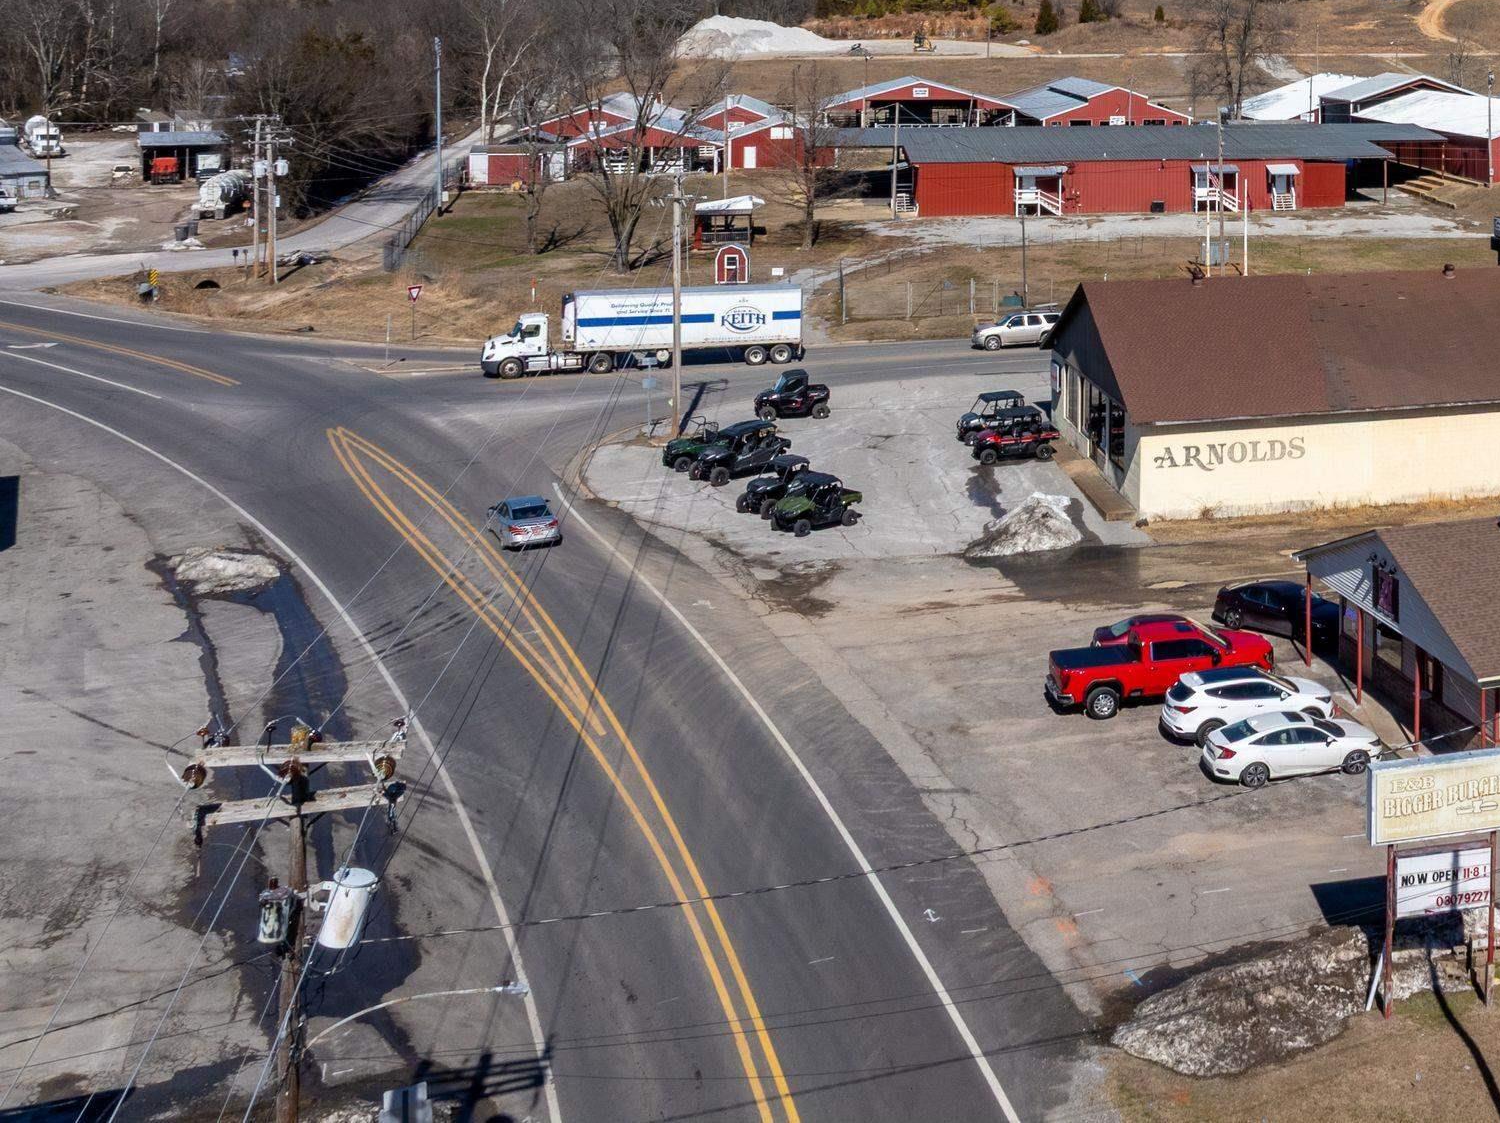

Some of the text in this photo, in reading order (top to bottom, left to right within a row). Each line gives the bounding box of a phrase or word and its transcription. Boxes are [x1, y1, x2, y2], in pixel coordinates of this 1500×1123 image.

[721, 313, 767, 328] KEITH
[1154, 437, 1306, 471] ARNOLDS
[1390, 776, 1435, 794] E&B
[1383, 789, 1443, 818] BIGGER
[1401, 873, 1427, 886] NOW
[1432, 869, 1459, 882] OPEN
